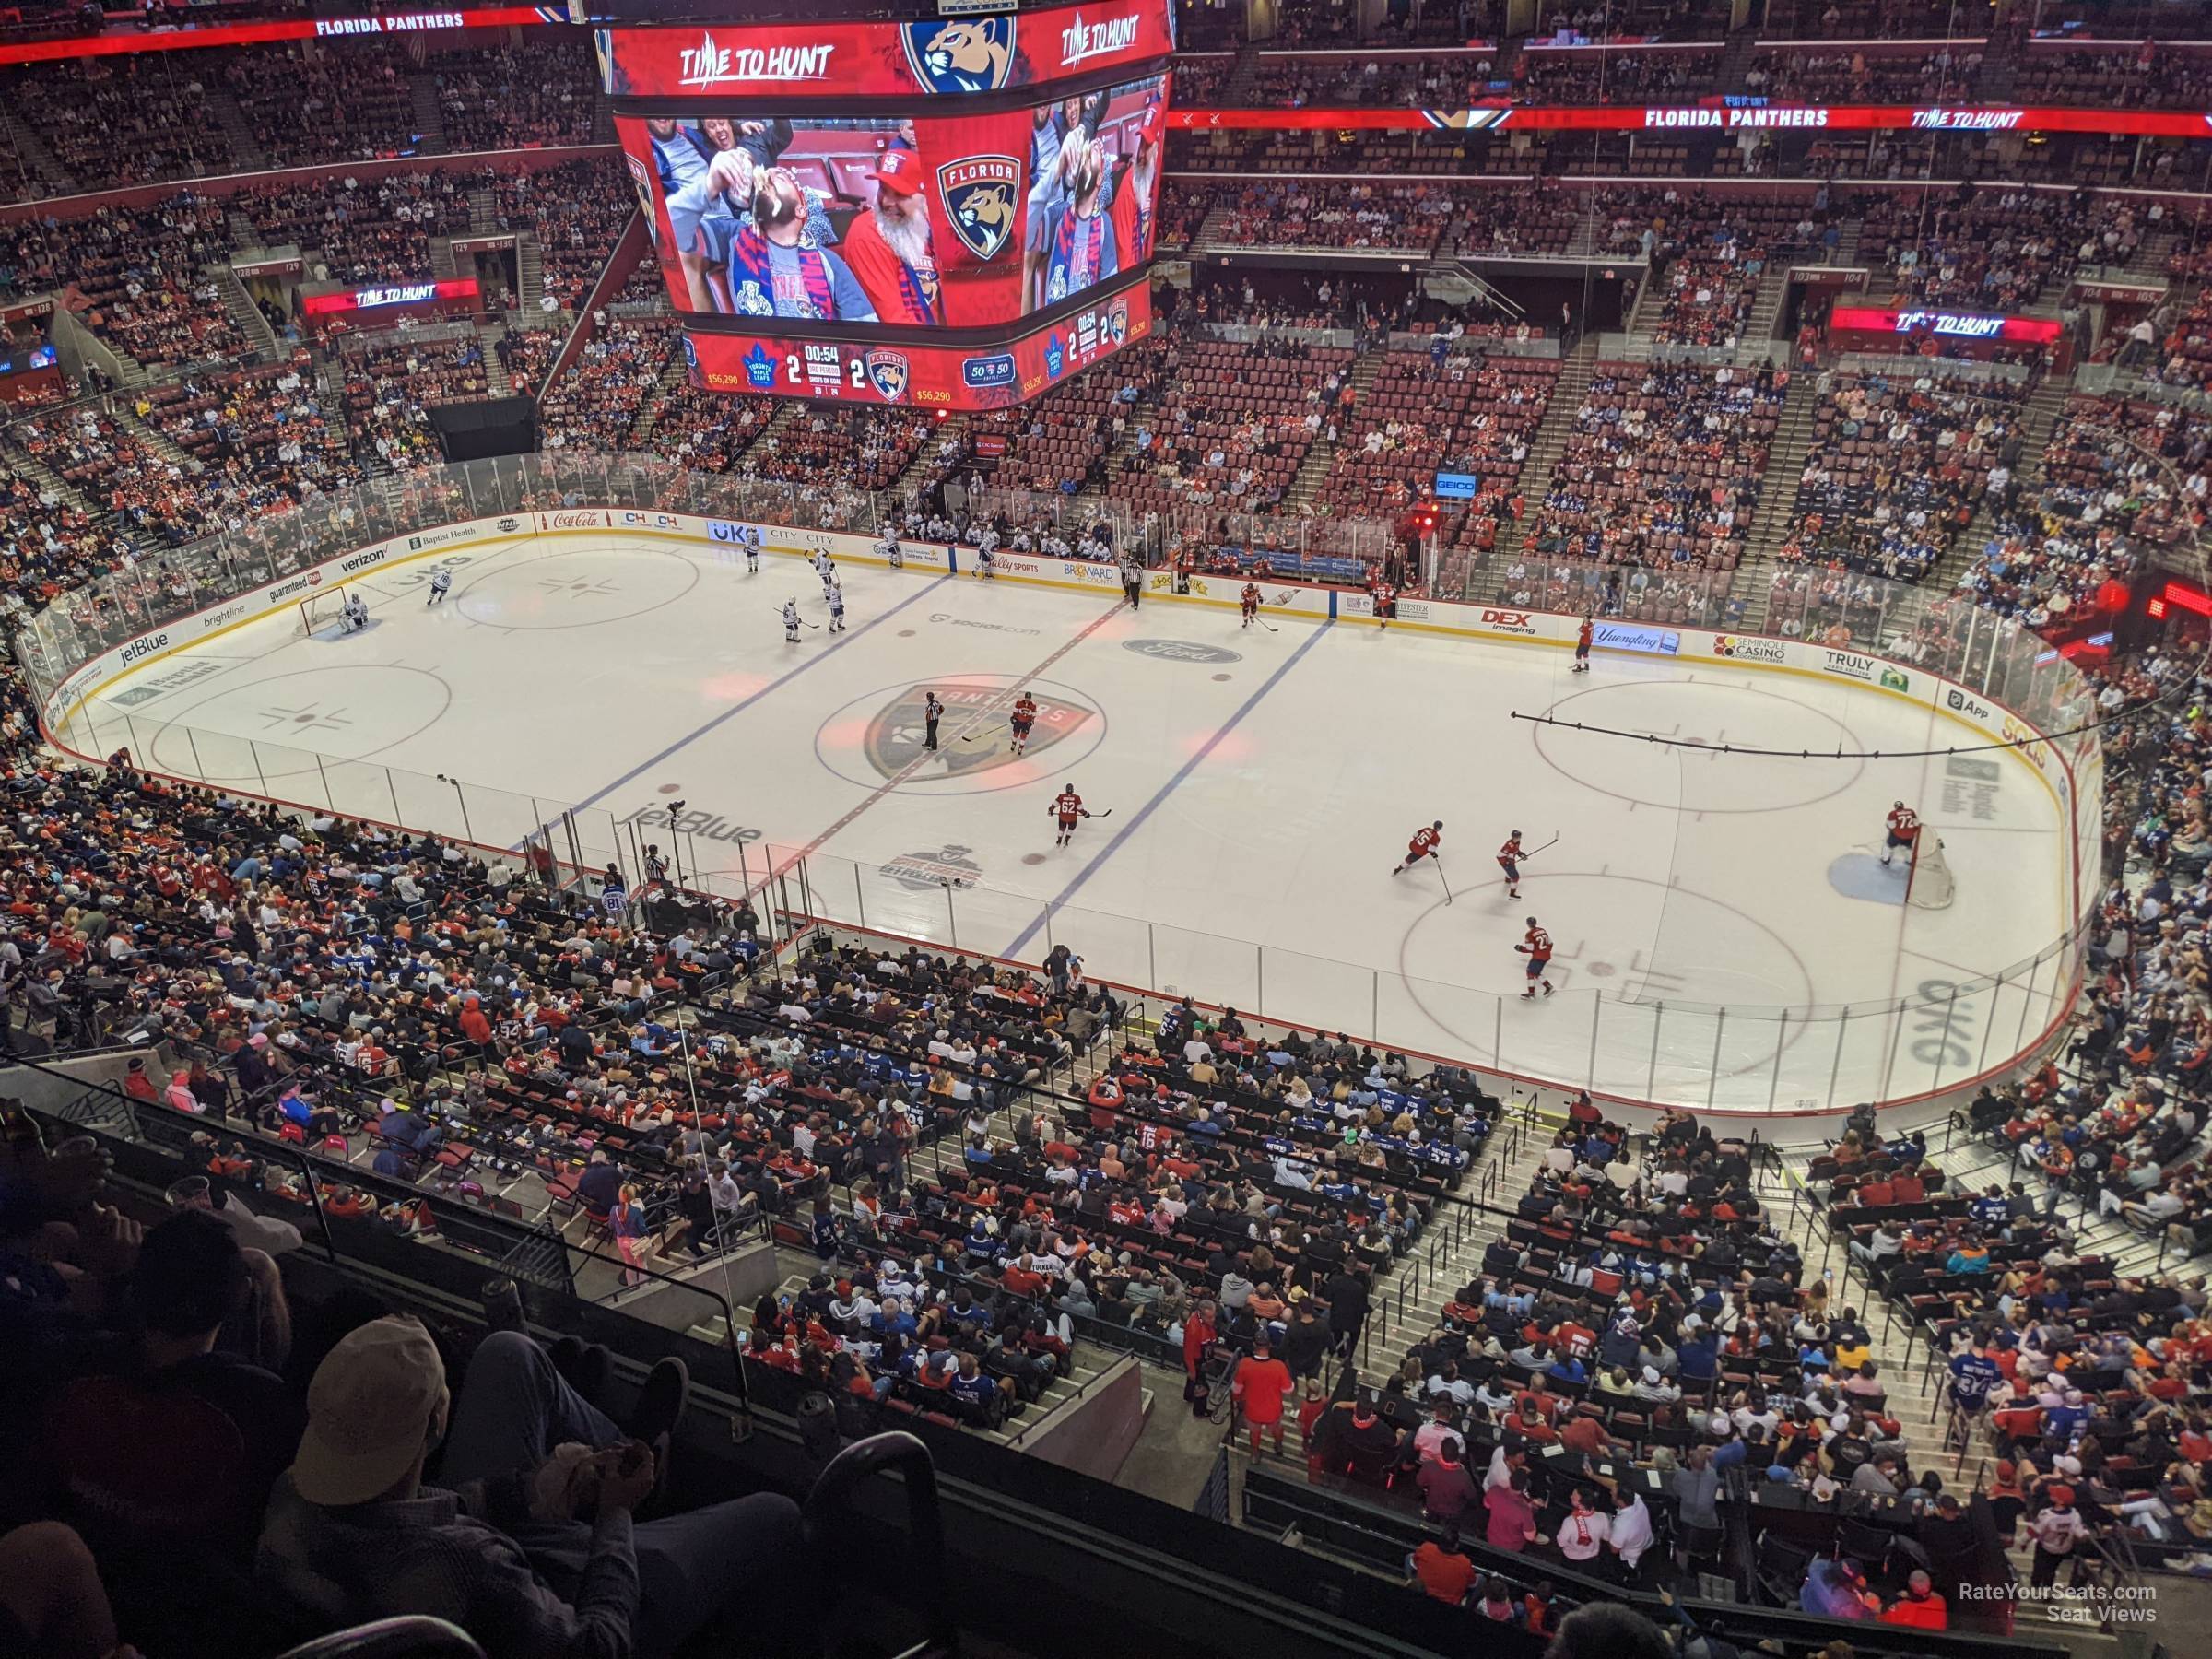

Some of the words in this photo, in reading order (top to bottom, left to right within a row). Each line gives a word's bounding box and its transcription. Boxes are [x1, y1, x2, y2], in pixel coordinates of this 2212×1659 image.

[945, 3, 1015, 11] FLORIDA
[316, 18, 382, 35] FLORIDA
[386, 14, 464, 30] PANTHERS
[1062, 10, 1089, 70] TIME
[1092, 24, 1107, 50] TO
[1107, 15, 1139, 47] HUNT
[680, 30, 732, 90] TIME
[736, 48, 764, 76] TO
[768, 44, 835, 77] HUNT
[1645, 110, 1722, 126] FLORIDA
[1730, 110, 1828, 126] PANTHERS
[1912, 109, 1948, 127] TIME
[1954, 112, 1974, 127] TO
[1975, 112, 2024, 127] HUNT
[948, 165, 1013, 185] FLORIDA
[455, 242, 468, 252] 129
[286, 262, 299, 272] 129
[356, 288, 383, 306] TIME
[385, 287, 402, 302] TO
[402, 284, 436, 300] HUNT
[1100, 316, 1108, 344] 2
[1936, 316, 1959, 333] TO
[1959, 318, 2005, 335] HUNT
[805, 345, 839, 362] 00:54
[1069, 332, 1077, 361] 2
[787, 355, 801, 383] 2
[850, 359, 865, 388] 2
[971, 367, 985, 377] 50
[997, 363, 1009, 375] 50
[708, 374, 738, 385] $56,290
[917, 391, 951, 402] $56,290
[1436, 480, 1475, 490] GEICO
[553, 511, 599, 528] Coca-Cola
[423, 532, 449, 546] Baptist
[450, 527, 476, 539] Health
[771, 530, 797, 540] CITY
[806, 535, 834, 545] CITY
[341, 548, 385, 573] verizon
[1014, 562, 1039, 573] SPORTS
[440, 574, 450, 583] 16
[1088, 577, 1113, 586] COUNTY
[270, 576, 307, 603] guaranteed
[1377, 590, 1386, 600] 12
[1397, 602, 1429, 612] YLVESTER
[204, 604, 245, 628] brightline
[1481, 610, 1532, 627] DEX
[951, 619, 1040, 635] socios.com
[1493, 624, 1535, 635] imaging
[1596, 626, 1659, 649] Yuengling
[1738, 636, 1786, 651] SEMINOLE
[119, 634, 168, 668] jetBlue
[1145, 642, 1218, 660] Ford
[1736, 646, 1785, 660] CASINO
[1826, 651, 1874, 671] TRULY
[2002, 716, 2047, 769] SOLIS
[1062, 801, 1075, 813] 62
[614, 801, 754, 841] jetBlue
[1897, 815, 1914, 829] 72
[607, 898, 620, 909] 81
[500, 1024, 519, 1039] 94
[1911, 979, 1974, 1067] ÜKG
[1141, 1131, 1155, 1150] 16
[1957, 1373, 1992, 1397] 34
